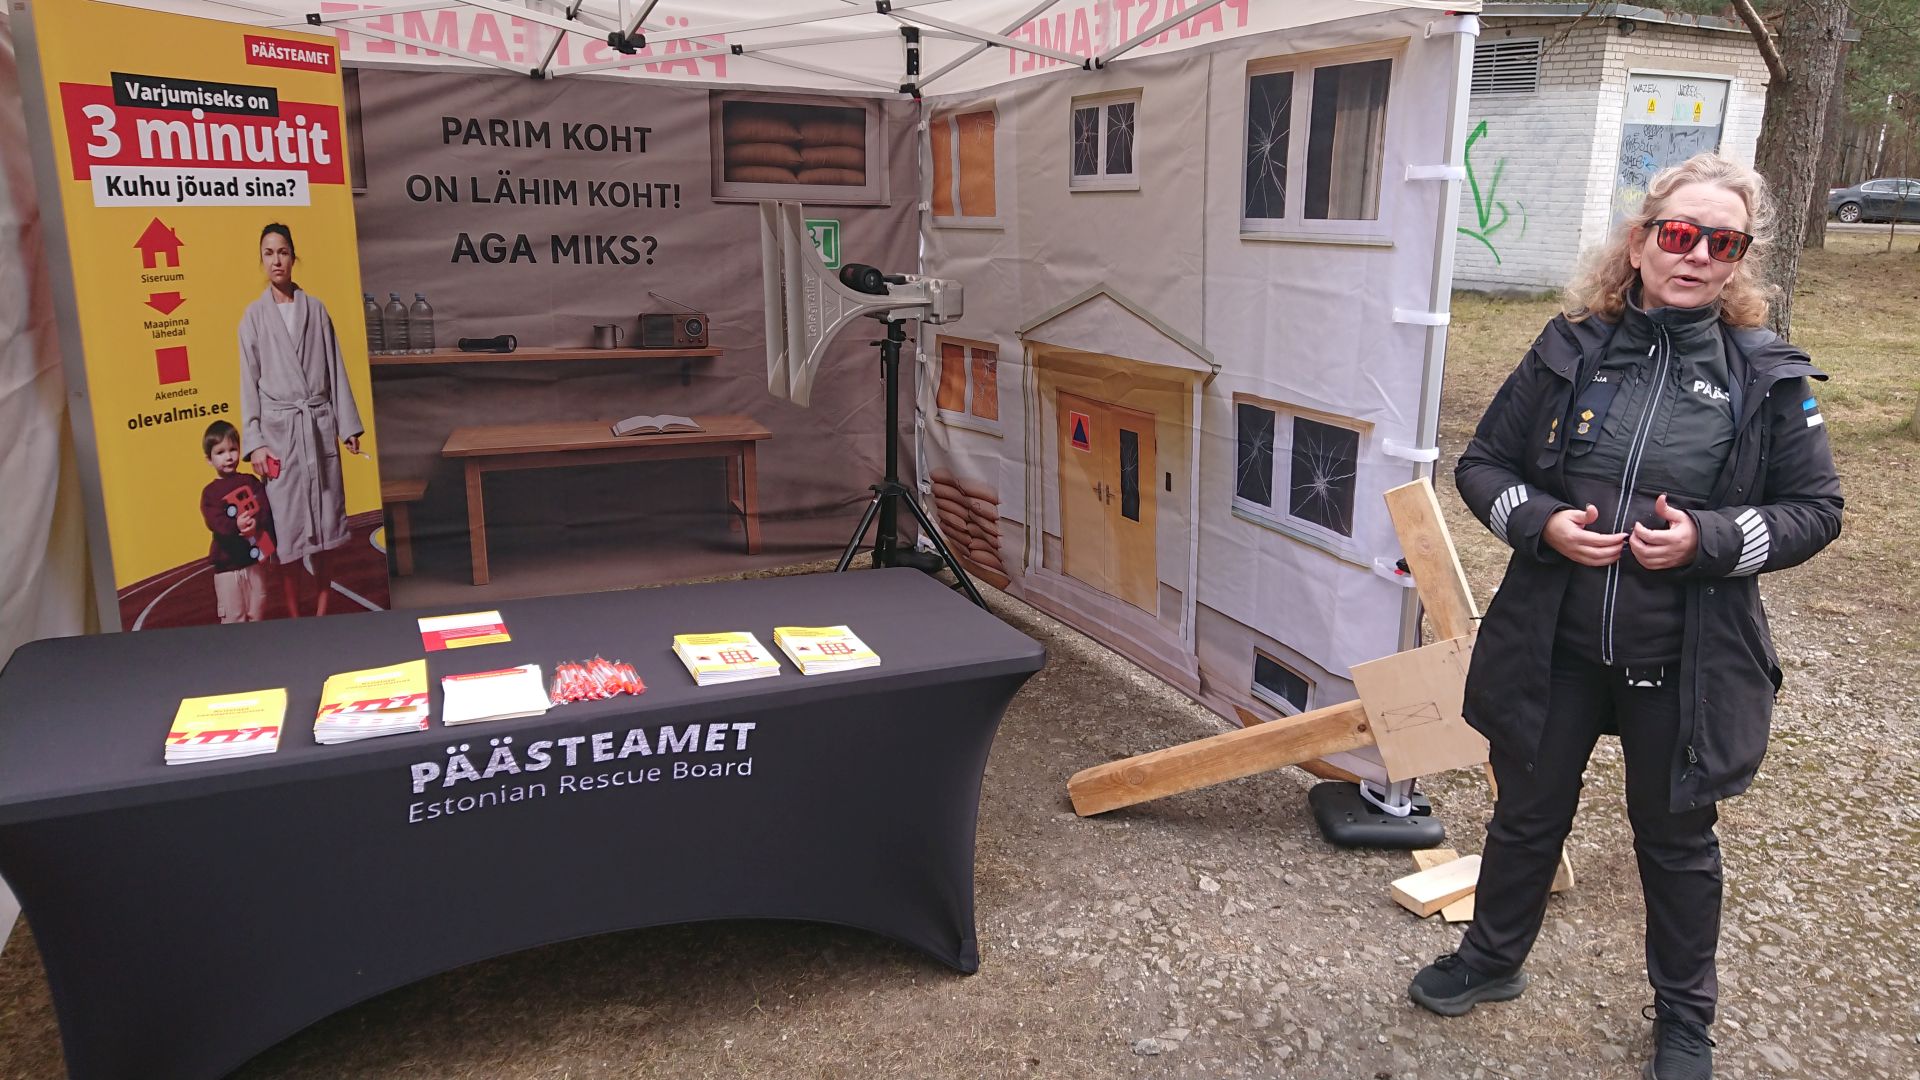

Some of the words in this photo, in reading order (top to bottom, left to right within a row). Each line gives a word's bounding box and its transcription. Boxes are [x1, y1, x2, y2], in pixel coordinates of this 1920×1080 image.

[251, 41, 330, 65] PÄÄSTEAMET
[125, 81, 244, 108] Varjumiseks
[248, 94, 269, 110] on
[82, 104, 122, 159] 3
[136, 108, 331, 165] minutit
[442, 116, 551, 149] PARIM
[562, 122, 652, 153] KOHT
[105, 175, 171, 198] Kuhu
[176, 175, 239, 202] jõuad
[245, 178, 296, 197] sina?
[406, 174, 458, 202] ON
[471, 169, 578, 206] LÄHIM
[588, 180, 681, 209] KOHT!
[450, 232, 537, 264] AGA
[551, 234, 658, 265] MIKS?
[141, 272, 185, 284] Siseruum
[144, 316, 190, 330] Maapinna
[152, 327, 186, 339] lähedal
[155, 387, 198, 400] Akendeta
[127, 401, 229, 430] olevalmis.ee
[410, 722, 756, 794] PÄÄSTEAMET
[409, 783, 546, 823] Estonian
[559, 767, 661, 794] Rescue
[673, 757, 753, 779] Board
